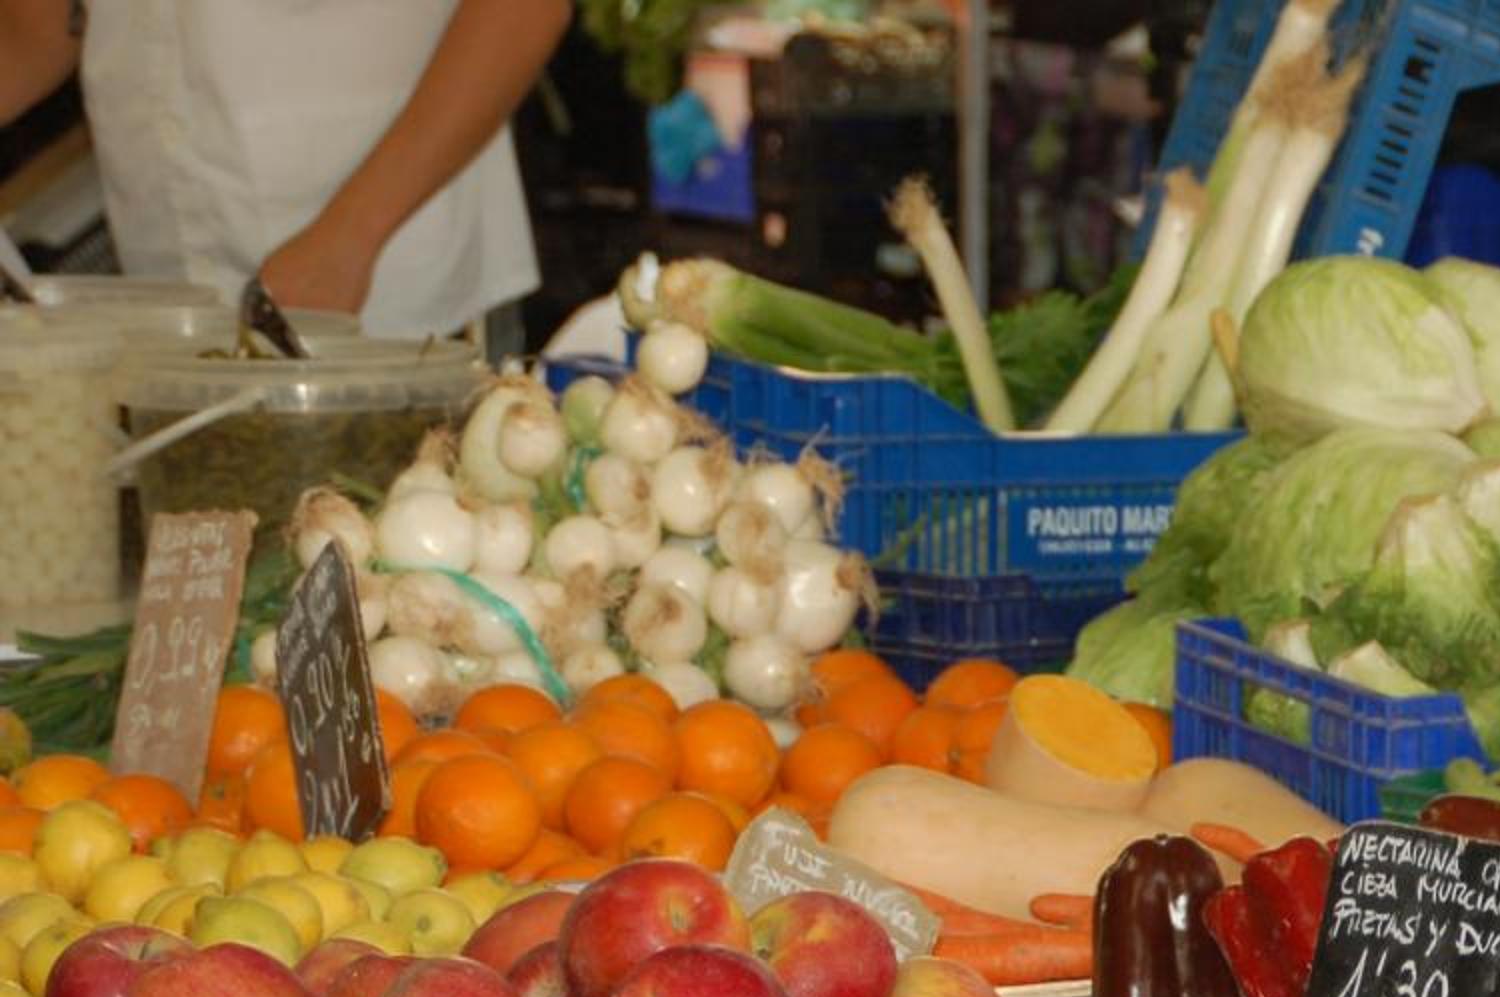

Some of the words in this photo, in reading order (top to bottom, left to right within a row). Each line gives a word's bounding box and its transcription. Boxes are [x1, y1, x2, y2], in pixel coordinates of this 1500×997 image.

[1027, 506, 1118, 538] PAQUITO
[1122, 505, 1176, 536] MAR
[1341, 832, 1462, 876] NECTARINA
